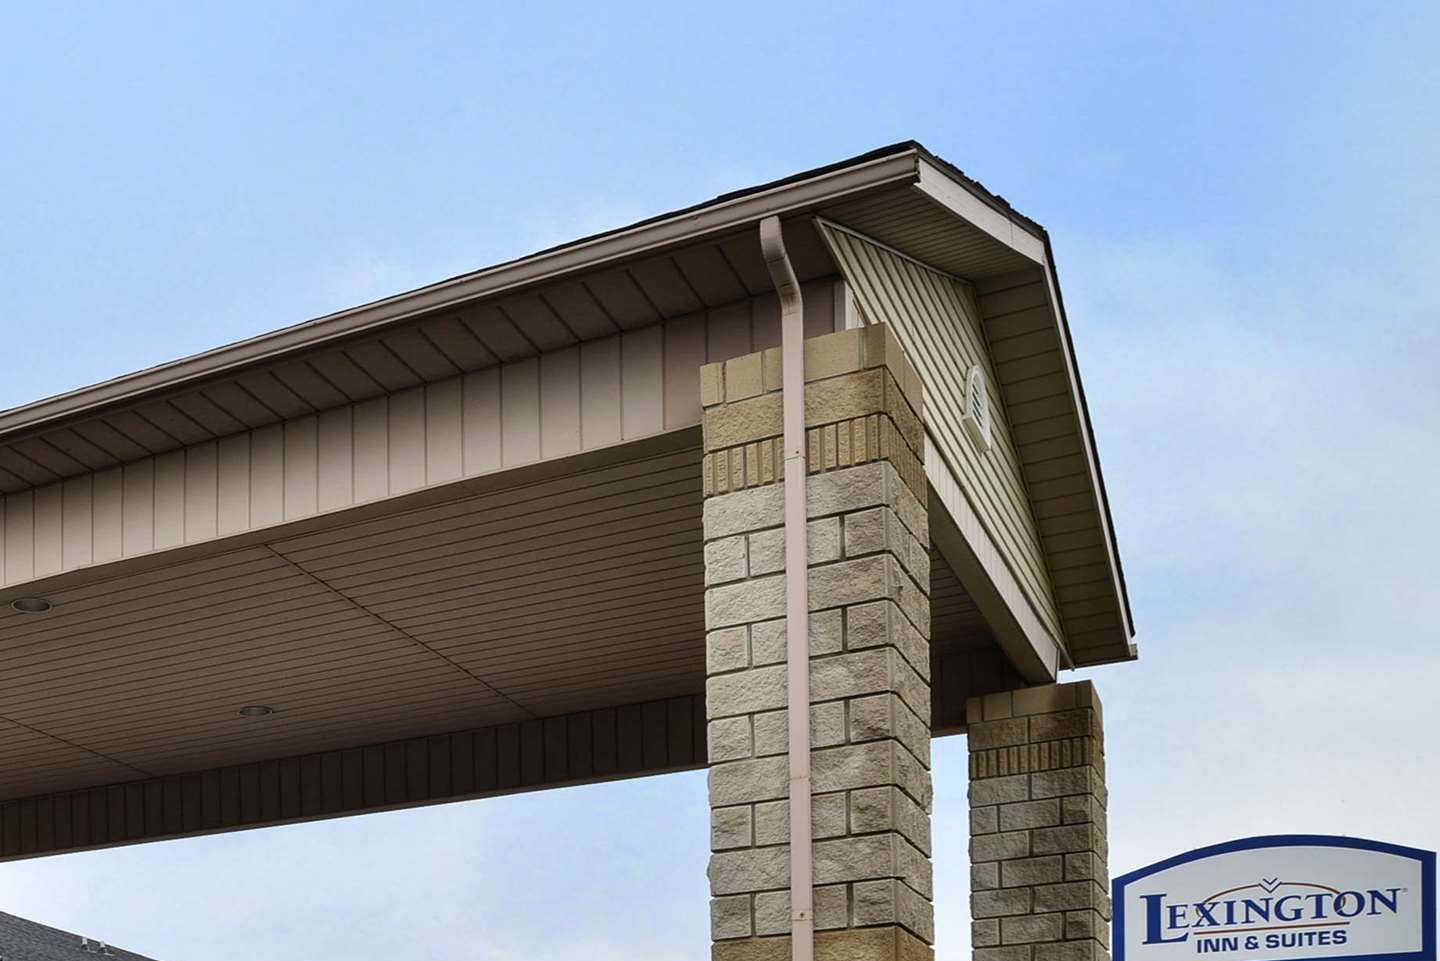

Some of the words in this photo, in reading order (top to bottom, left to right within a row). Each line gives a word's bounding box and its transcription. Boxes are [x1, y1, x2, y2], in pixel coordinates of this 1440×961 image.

[1197, 937, 1238, 953] INN
[1244, 935, 1260, 950] &
[1265, 930, 1347, 949] SUITES
